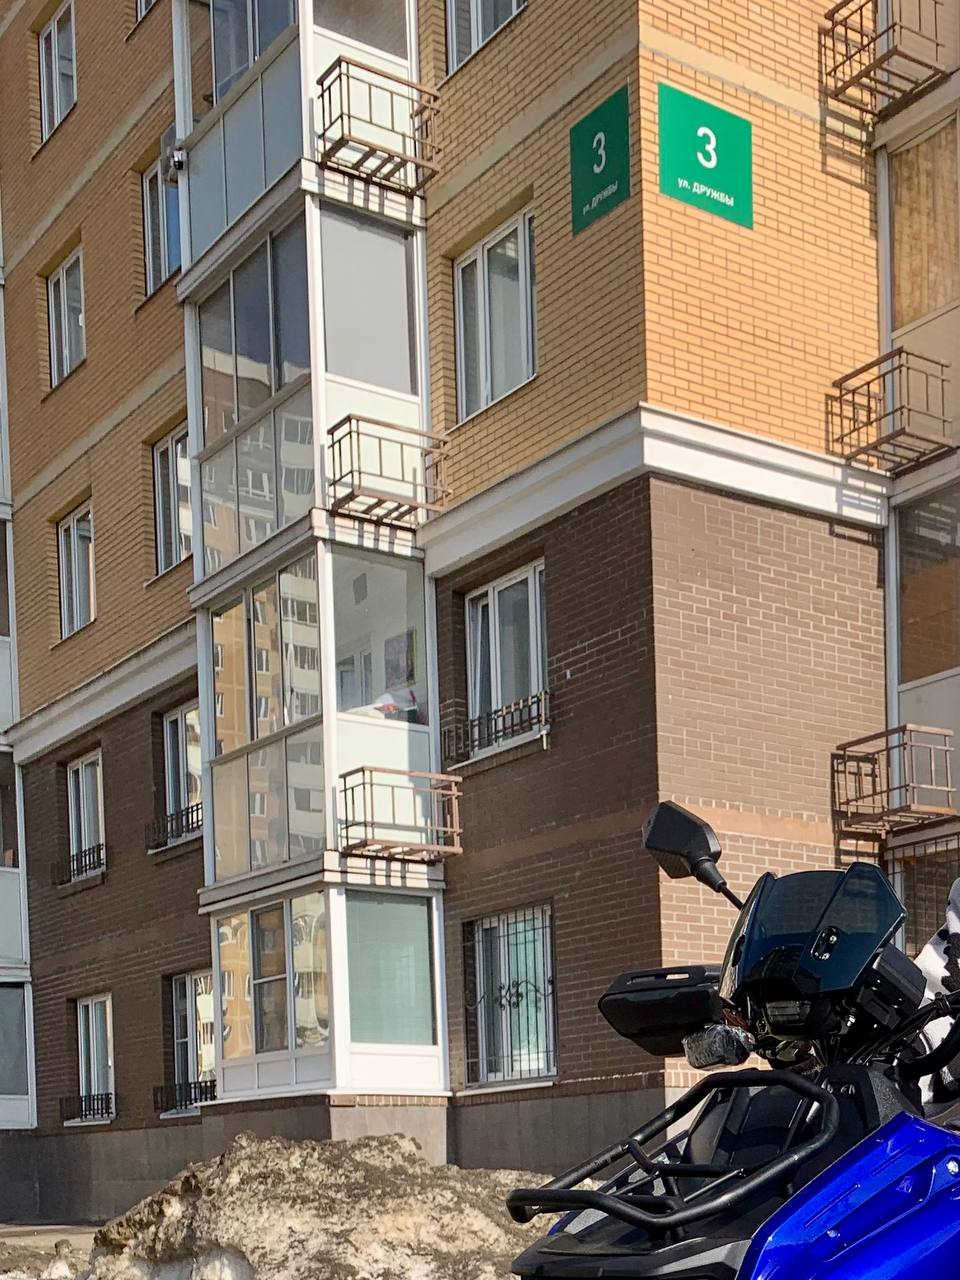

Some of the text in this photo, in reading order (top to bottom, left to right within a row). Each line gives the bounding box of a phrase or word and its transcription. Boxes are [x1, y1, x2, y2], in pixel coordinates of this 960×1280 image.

[592, 131, 606, 174] 3
[696, 126, 718, 169] 3
[677, 177, 735, 207] ул. ДРУЖБЫ
